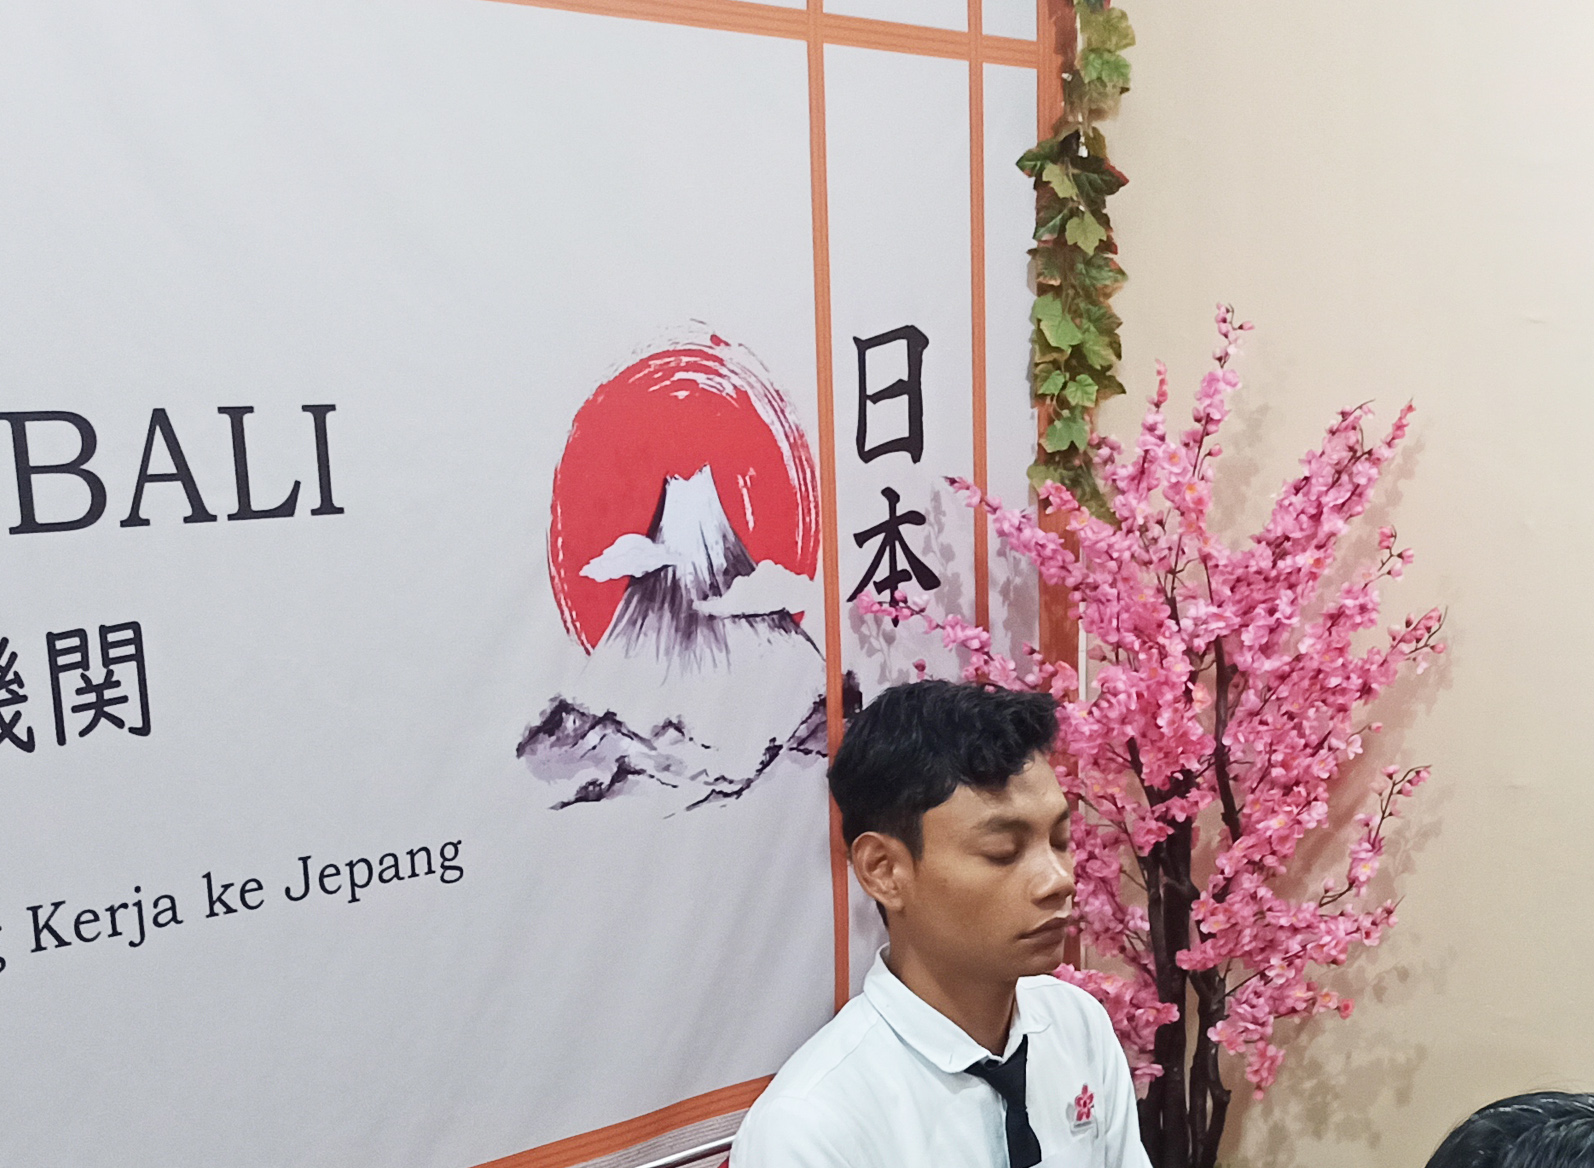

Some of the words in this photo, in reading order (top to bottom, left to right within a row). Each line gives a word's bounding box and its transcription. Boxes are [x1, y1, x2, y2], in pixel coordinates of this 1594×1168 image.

[0, 404, 345, 535] BALI
[847, 325, 942, 628] 日本
[26, 885, 184, 953] Kerja
[202, 856, 265, 918] ke
[284, 839, 465, 904] Jepang
